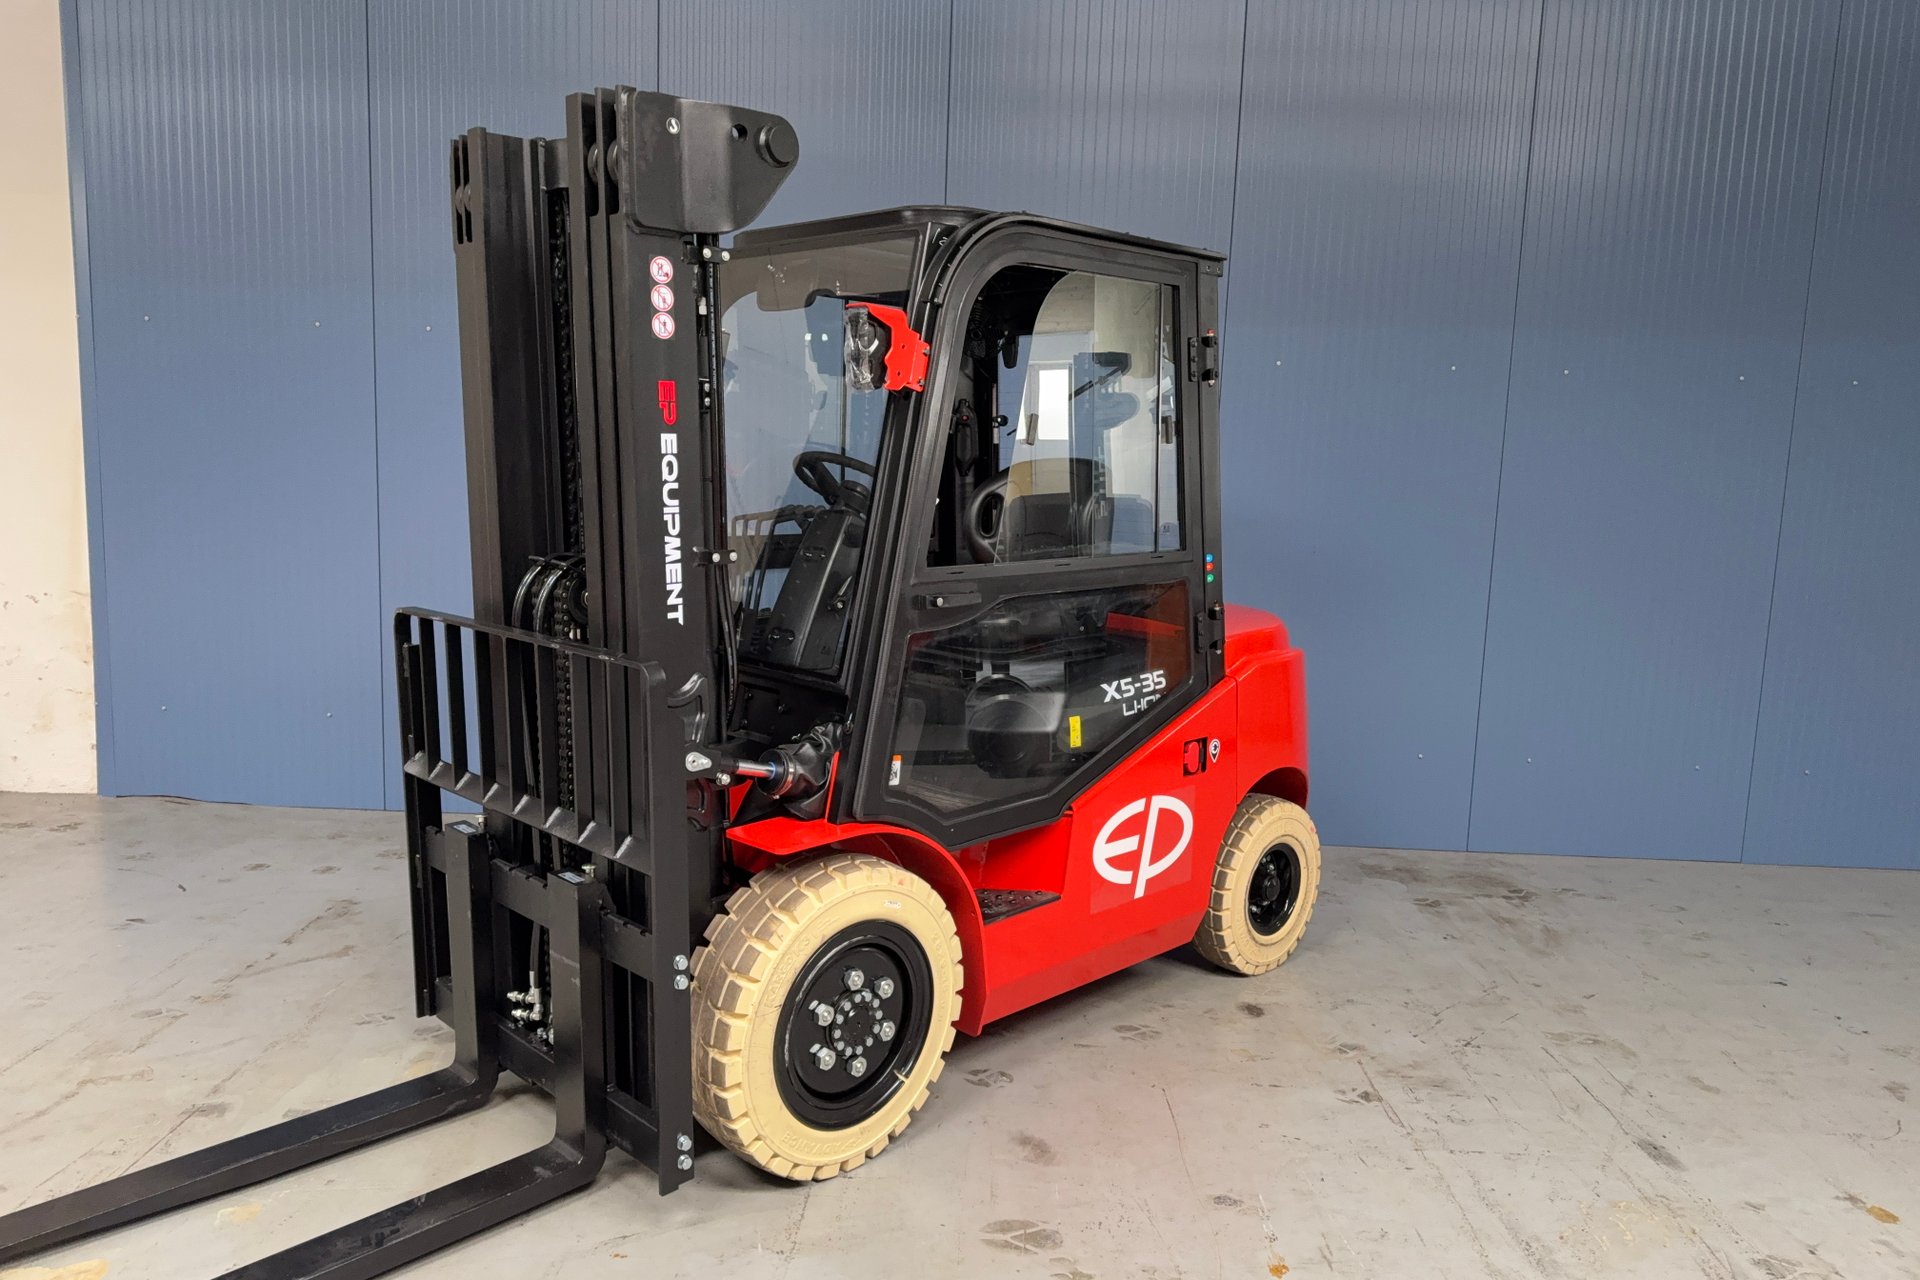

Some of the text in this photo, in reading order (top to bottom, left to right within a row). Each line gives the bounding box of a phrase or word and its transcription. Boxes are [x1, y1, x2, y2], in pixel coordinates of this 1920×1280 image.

[656, 379, 684, 626] EP EQUIPMENT
[1100, 670, 1167, 703] X5-35
[1093, 795, 1194, 899] EP
